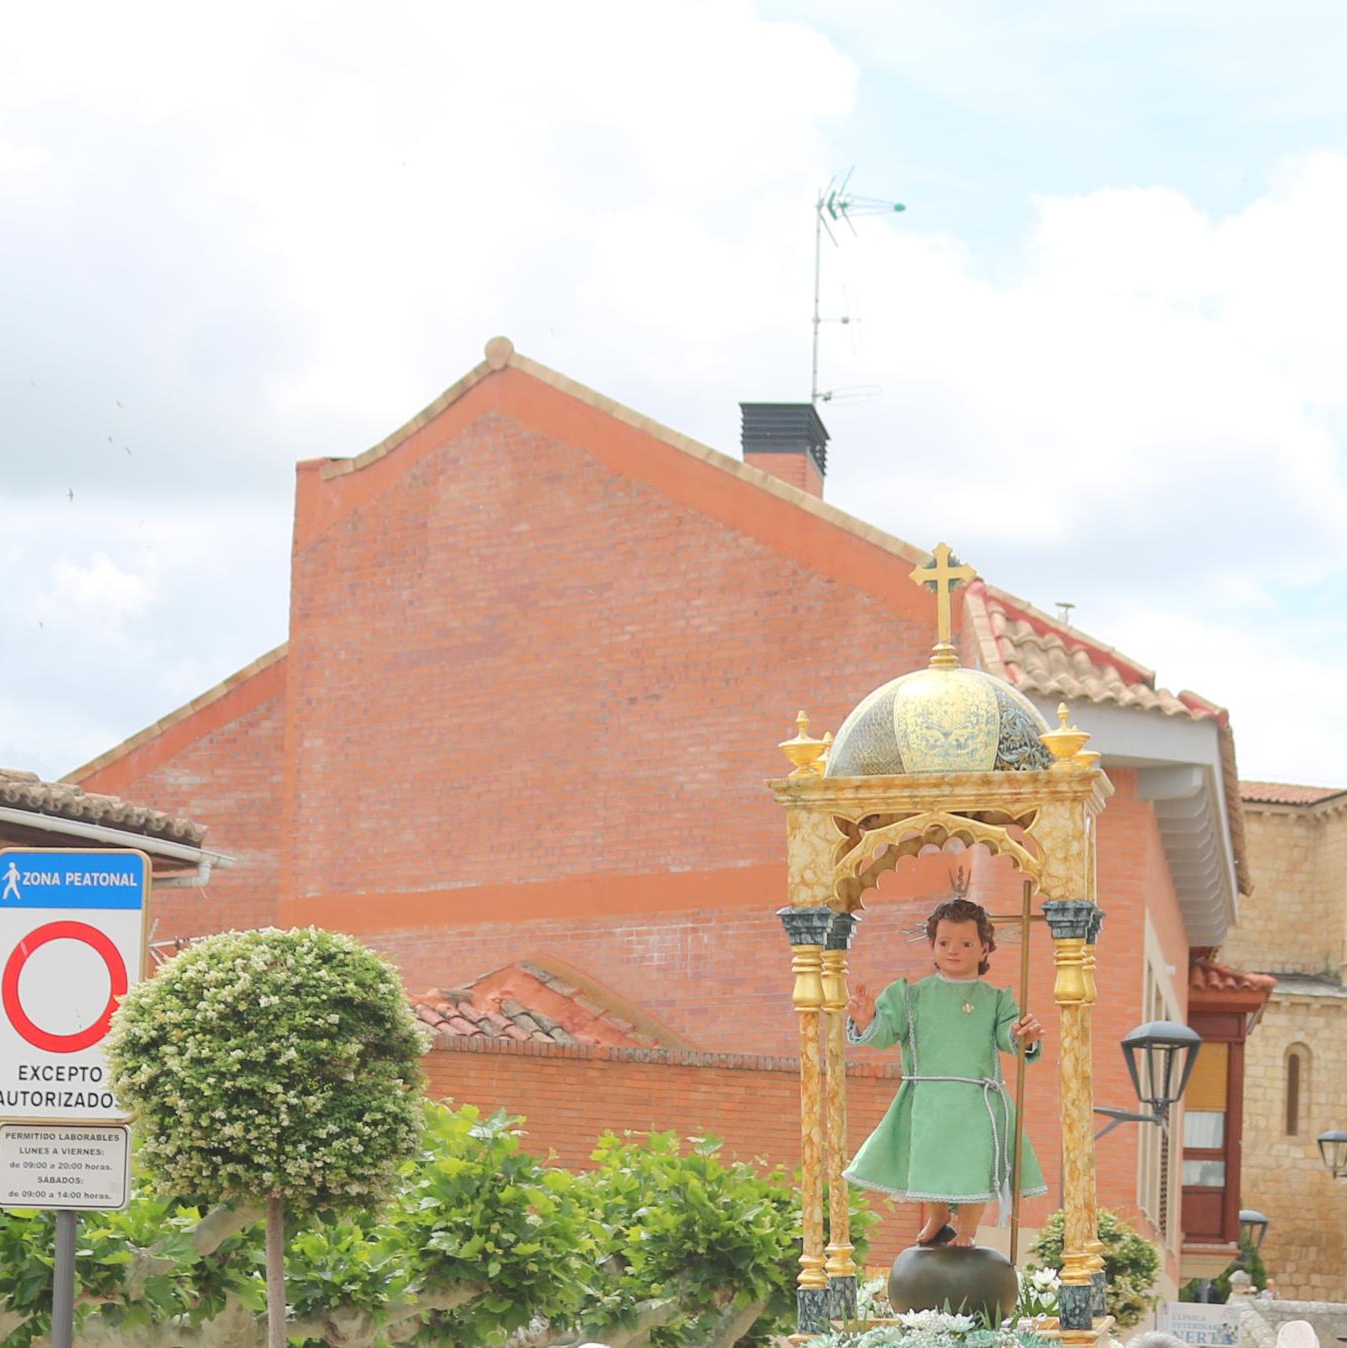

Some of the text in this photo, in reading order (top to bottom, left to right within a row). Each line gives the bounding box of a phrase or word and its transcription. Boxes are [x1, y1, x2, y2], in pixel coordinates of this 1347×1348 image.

[22, 872, 137, 887] ZONA PEATONAL
[18, 1065, 102, 1083] EXCEPTO
[5, 1132, 120, 1142] PERMITIDO LABORABLES
[19, 1147, 49, 1155] LUNES
[52, 1147, 58, 1155] A
[9, 1161, 20, 1169] de
[23, 1161, 47, 1169] 09:00
[58, 1162, 82, 1170] 20:00
[8, 1190, 19, 1198] de
[21, 1190, 46, 1198] 09:00
[57, 1191, 82, 1199] 14:00
